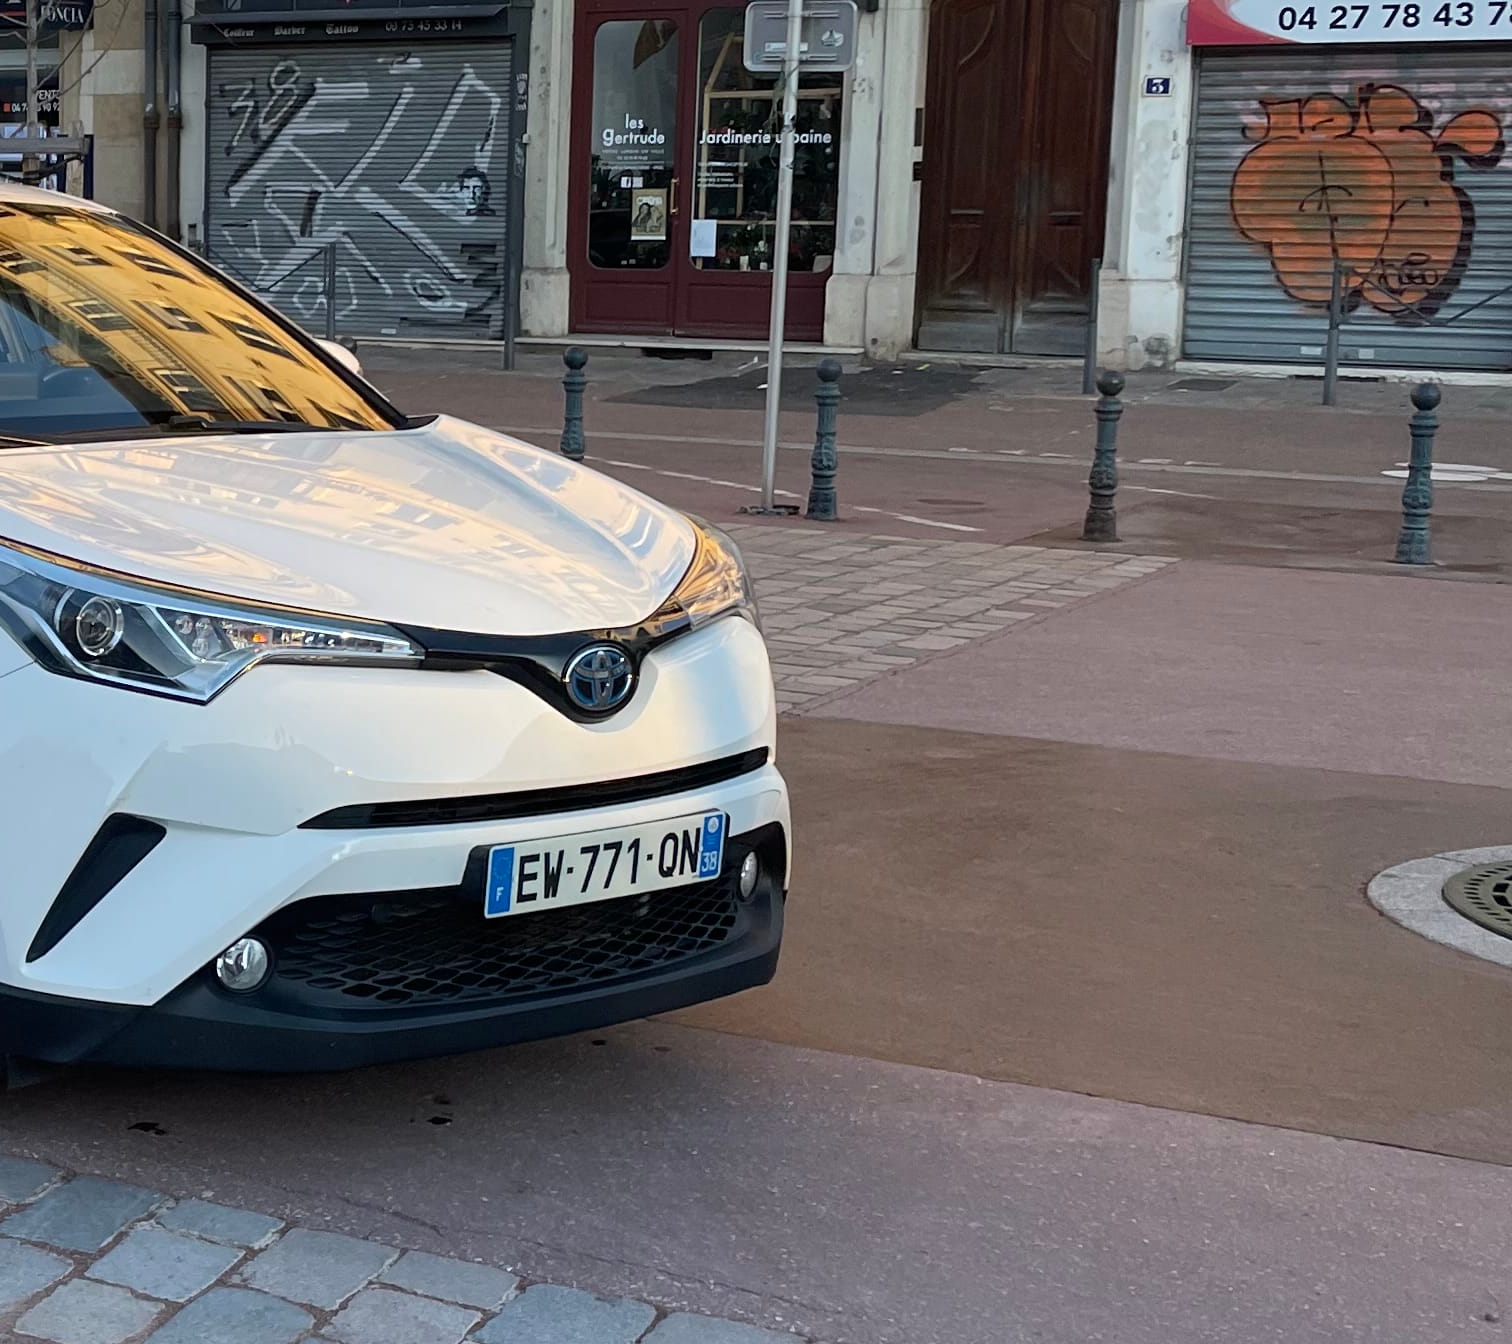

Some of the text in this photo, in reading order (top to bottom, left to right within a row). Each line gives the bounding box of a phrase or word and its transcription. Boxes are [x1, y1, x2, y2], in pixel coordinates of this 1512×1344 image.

[1278, 6, 1317, 31] 04
[1329, 5, 1369, 29] 27
[1381, 3, 1421, 29] 78
[1433, 1, 1474, 27] 43
[625, 113, 644, 130] les
[602, 126, 666, 146] gertrude
[699, 127, 771, 145] Jardinerie
[495, 827, 718, 904] F EW-771-QN 38
